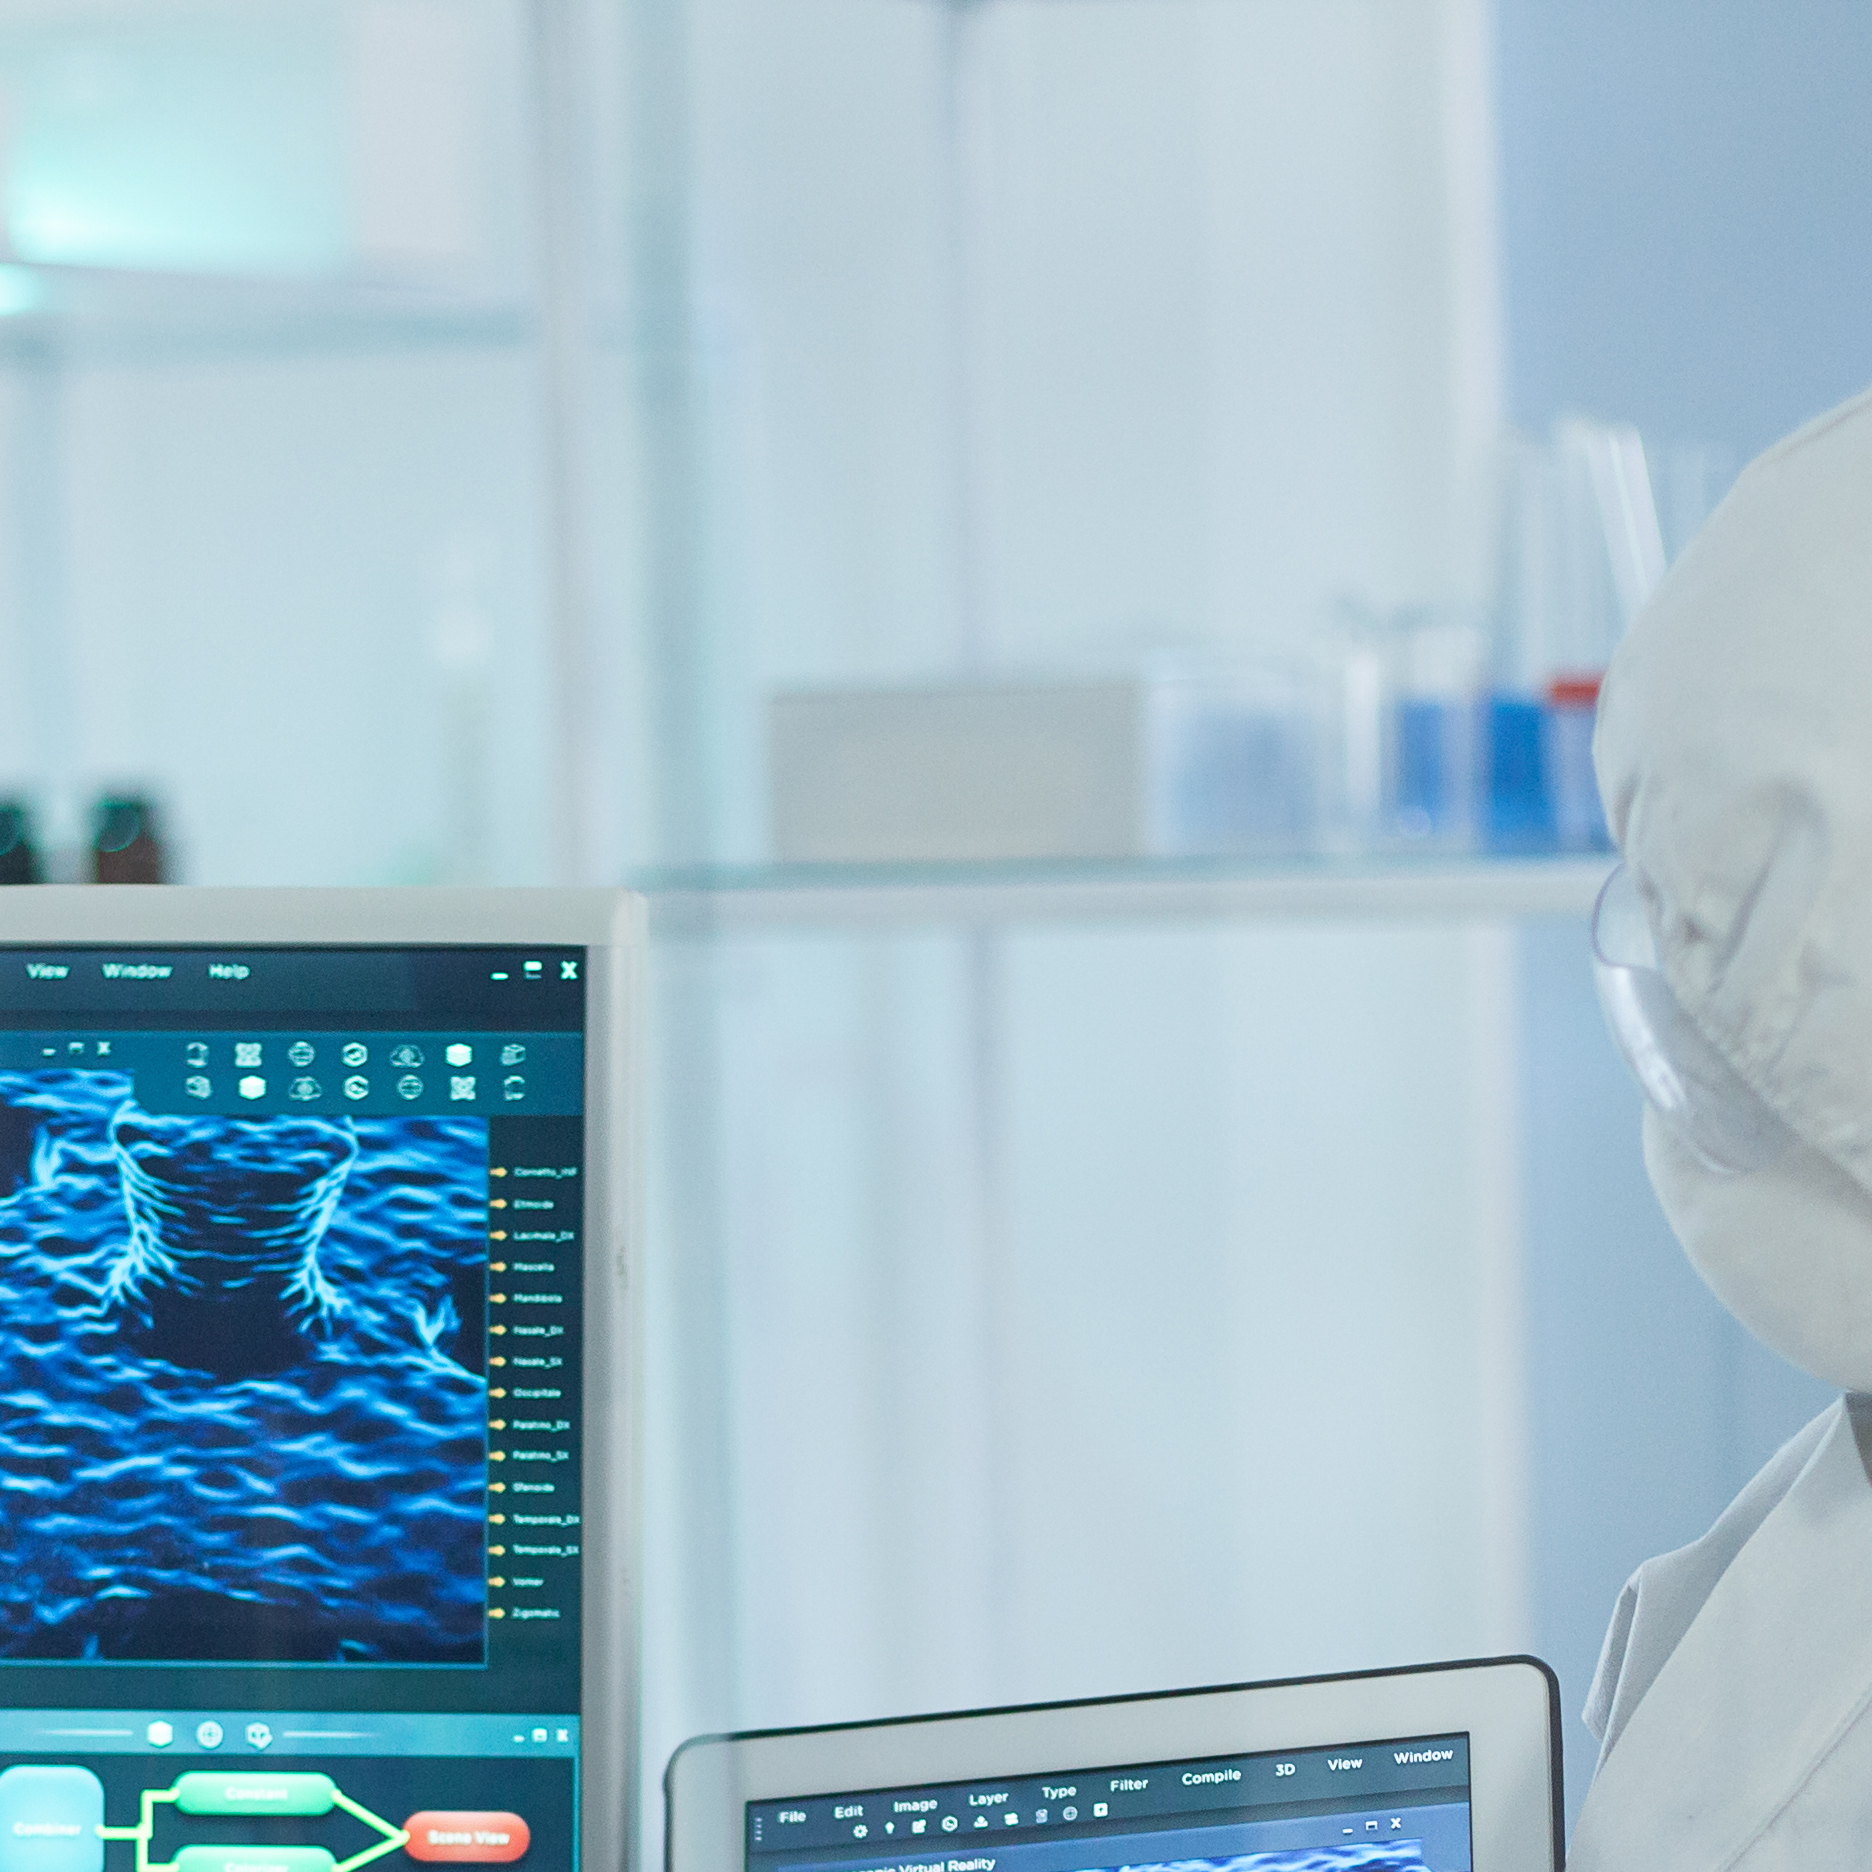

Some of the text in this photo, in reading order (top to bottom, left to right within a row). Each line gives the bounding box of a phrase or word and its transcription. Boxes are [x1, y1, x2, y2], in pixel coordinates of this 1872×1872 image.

[26, 963, 70, 980] View
[102, 963, 174, 980] Window
[207, 963, 250, 982] Help
[779, 1746, 1454, 1824] File Edit Image Layer Type Filter Compile 3D View Window
[472, 1829, 510, 1847] View
